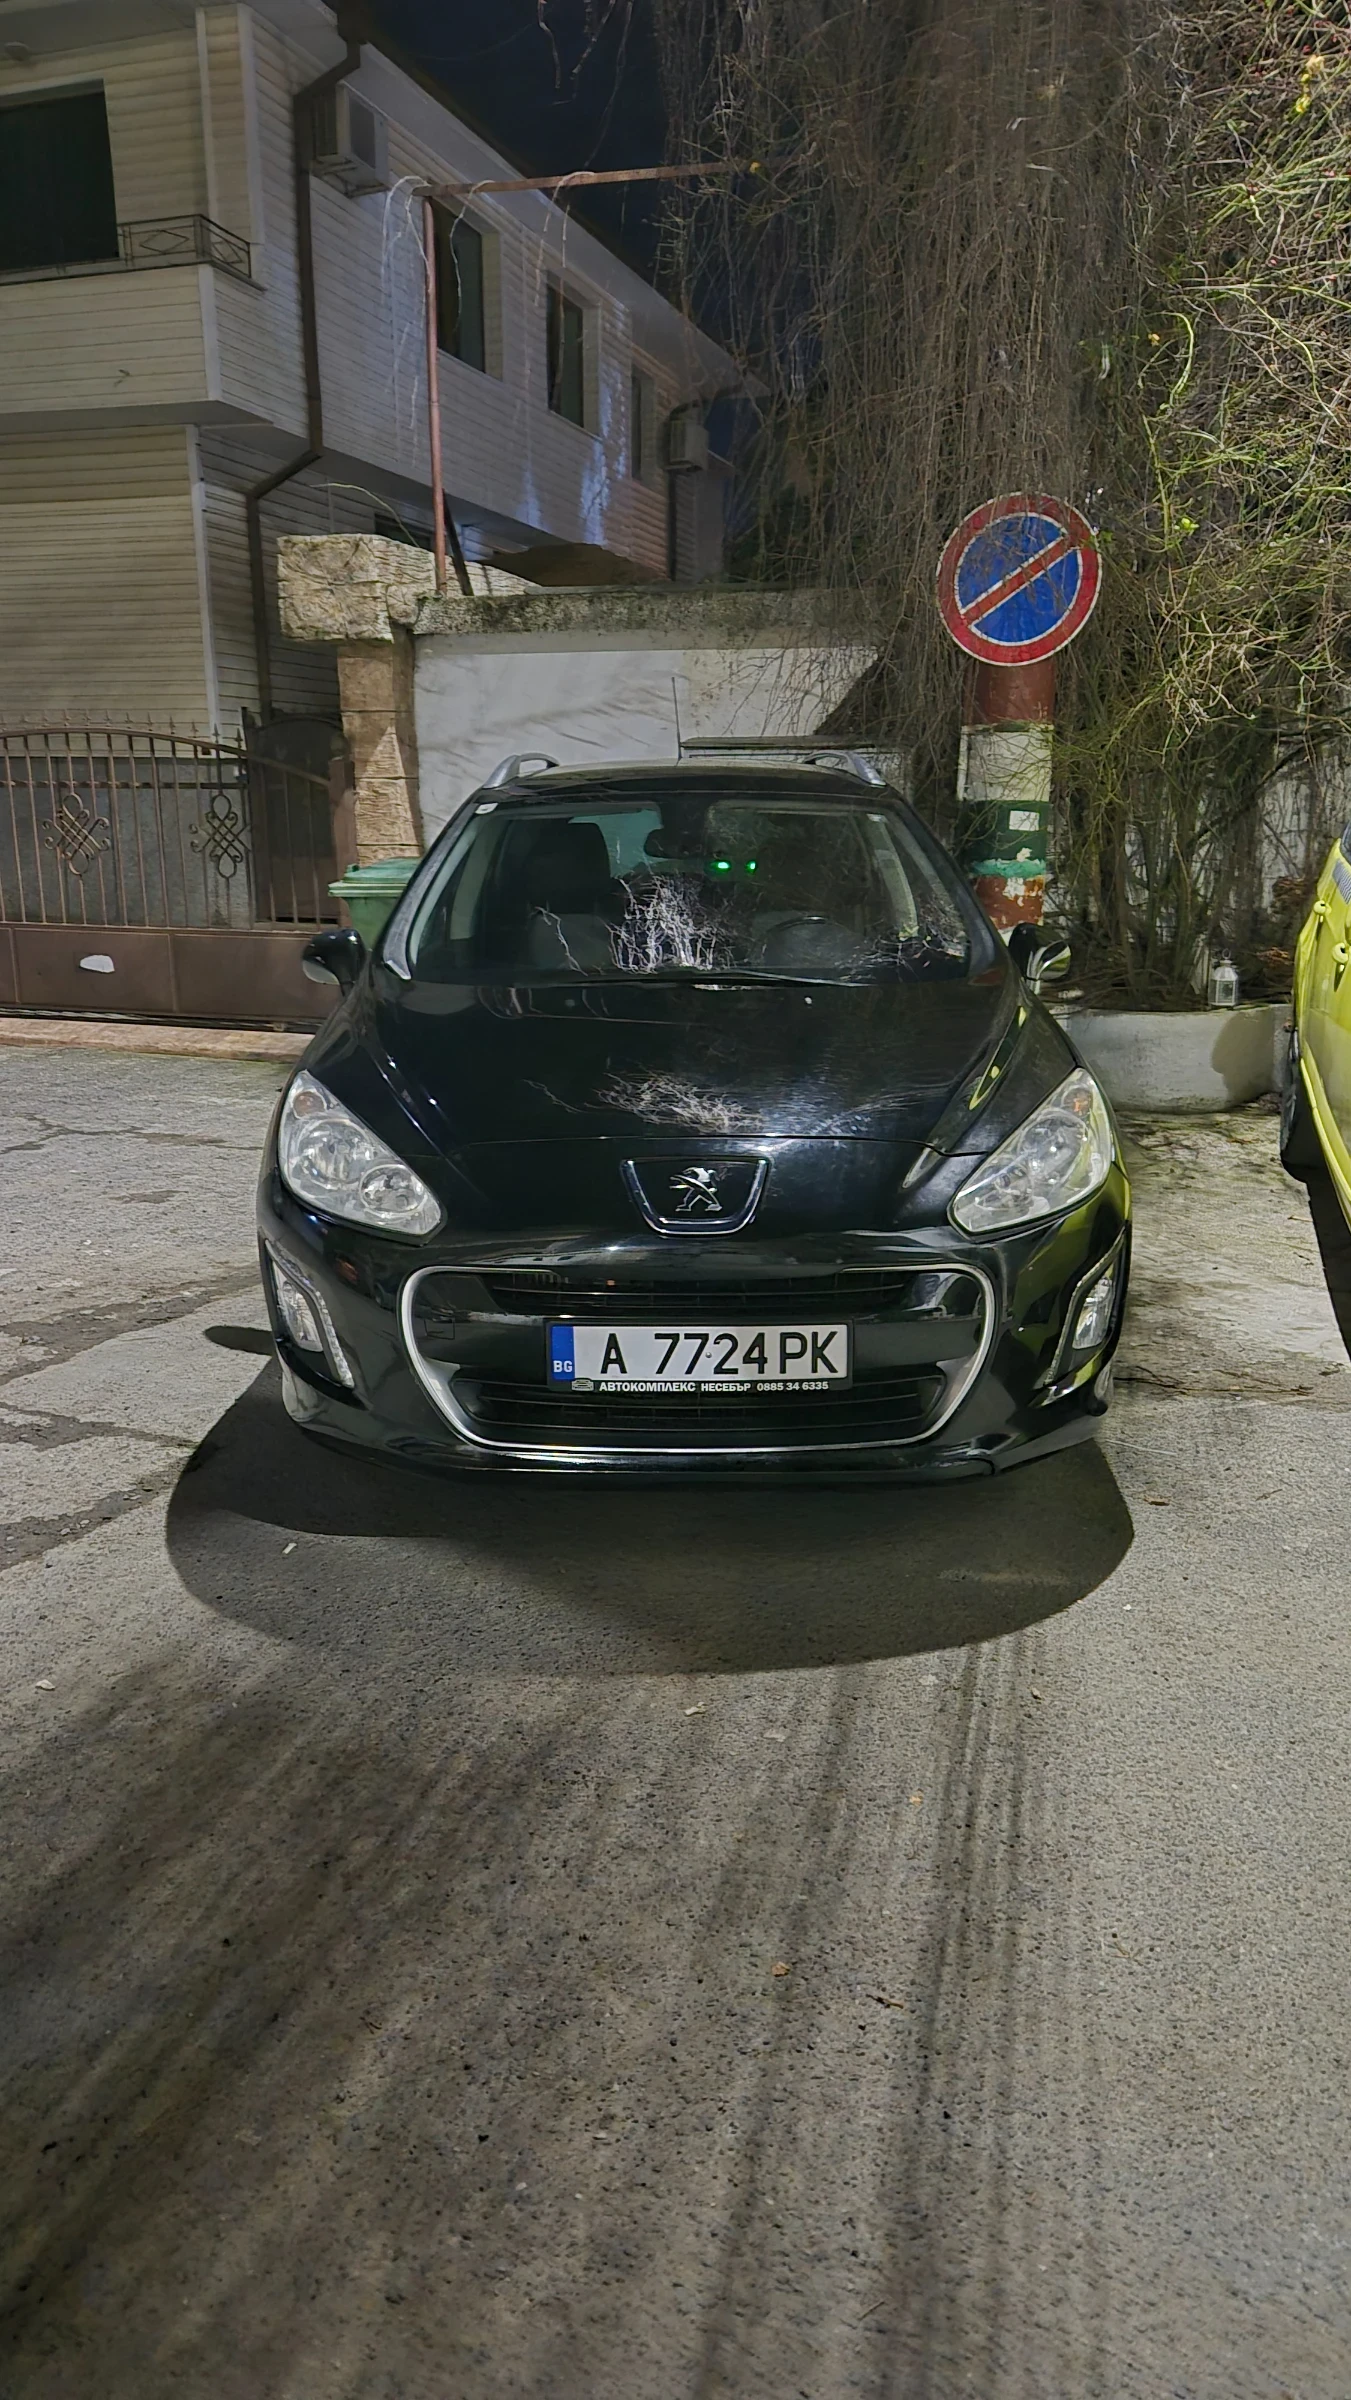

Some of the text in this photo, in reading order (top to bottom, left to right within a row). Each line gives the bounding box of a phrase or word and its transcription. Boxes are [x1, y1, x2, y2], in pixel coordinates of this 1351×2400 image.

[600, 1332, 629, 1375] A
[552, 1360, 574, 1373] BG
[599, 1381, 830, 1393] АВТОКОМПЛЕКС НЕСЕБЪР 0885 34 6335
